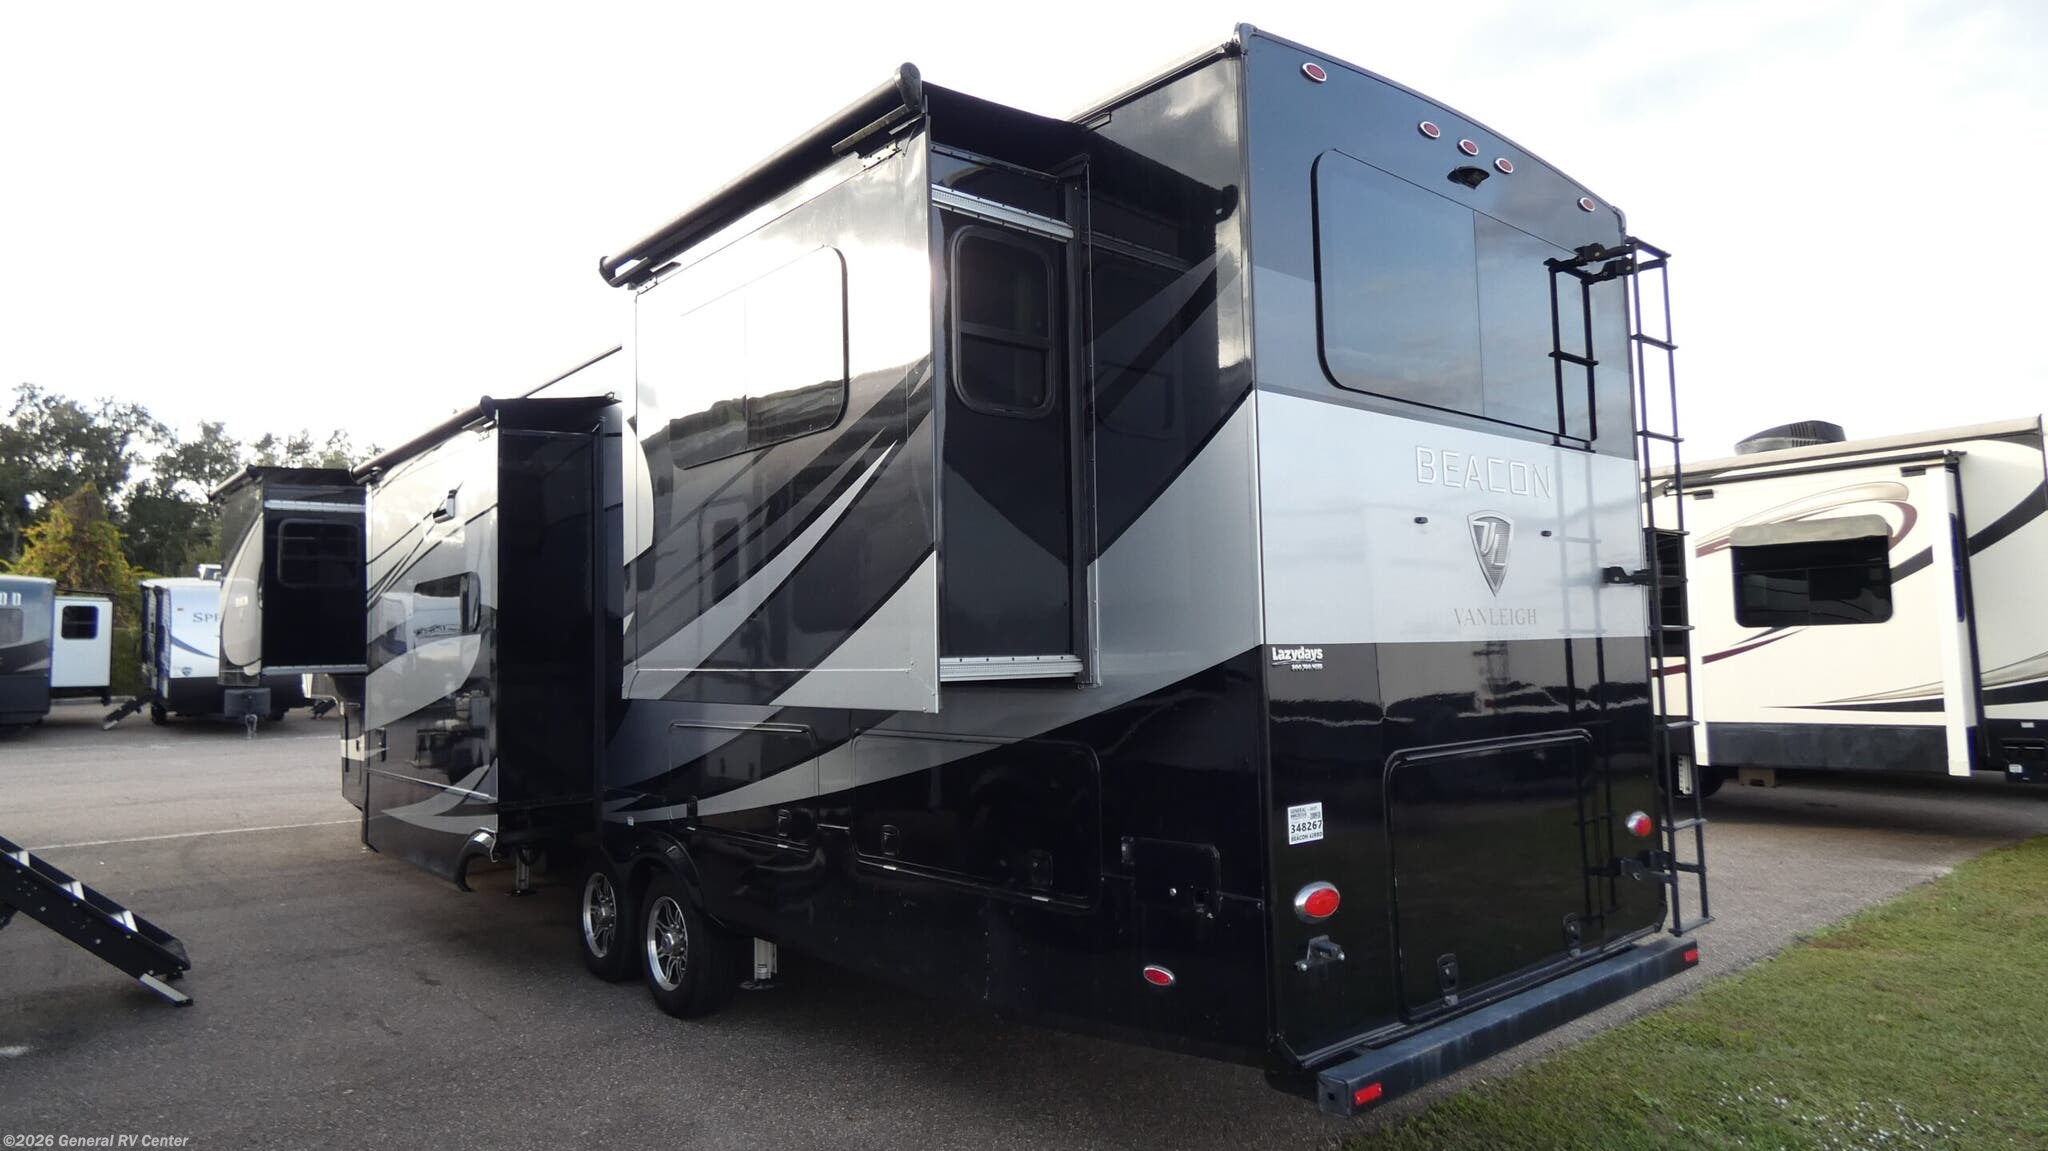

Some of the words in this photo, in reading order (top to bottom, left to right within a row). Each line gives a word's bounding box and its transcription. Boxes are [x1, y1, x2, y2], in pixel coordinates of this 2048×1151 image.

[1416, 446, 1551, 498] BEACON
[1454, 608, 1537, 625] VANLEIGH
[1272, 646, 1323, 661] Lazydays
[1290, 820, 1322, 834] 348267
